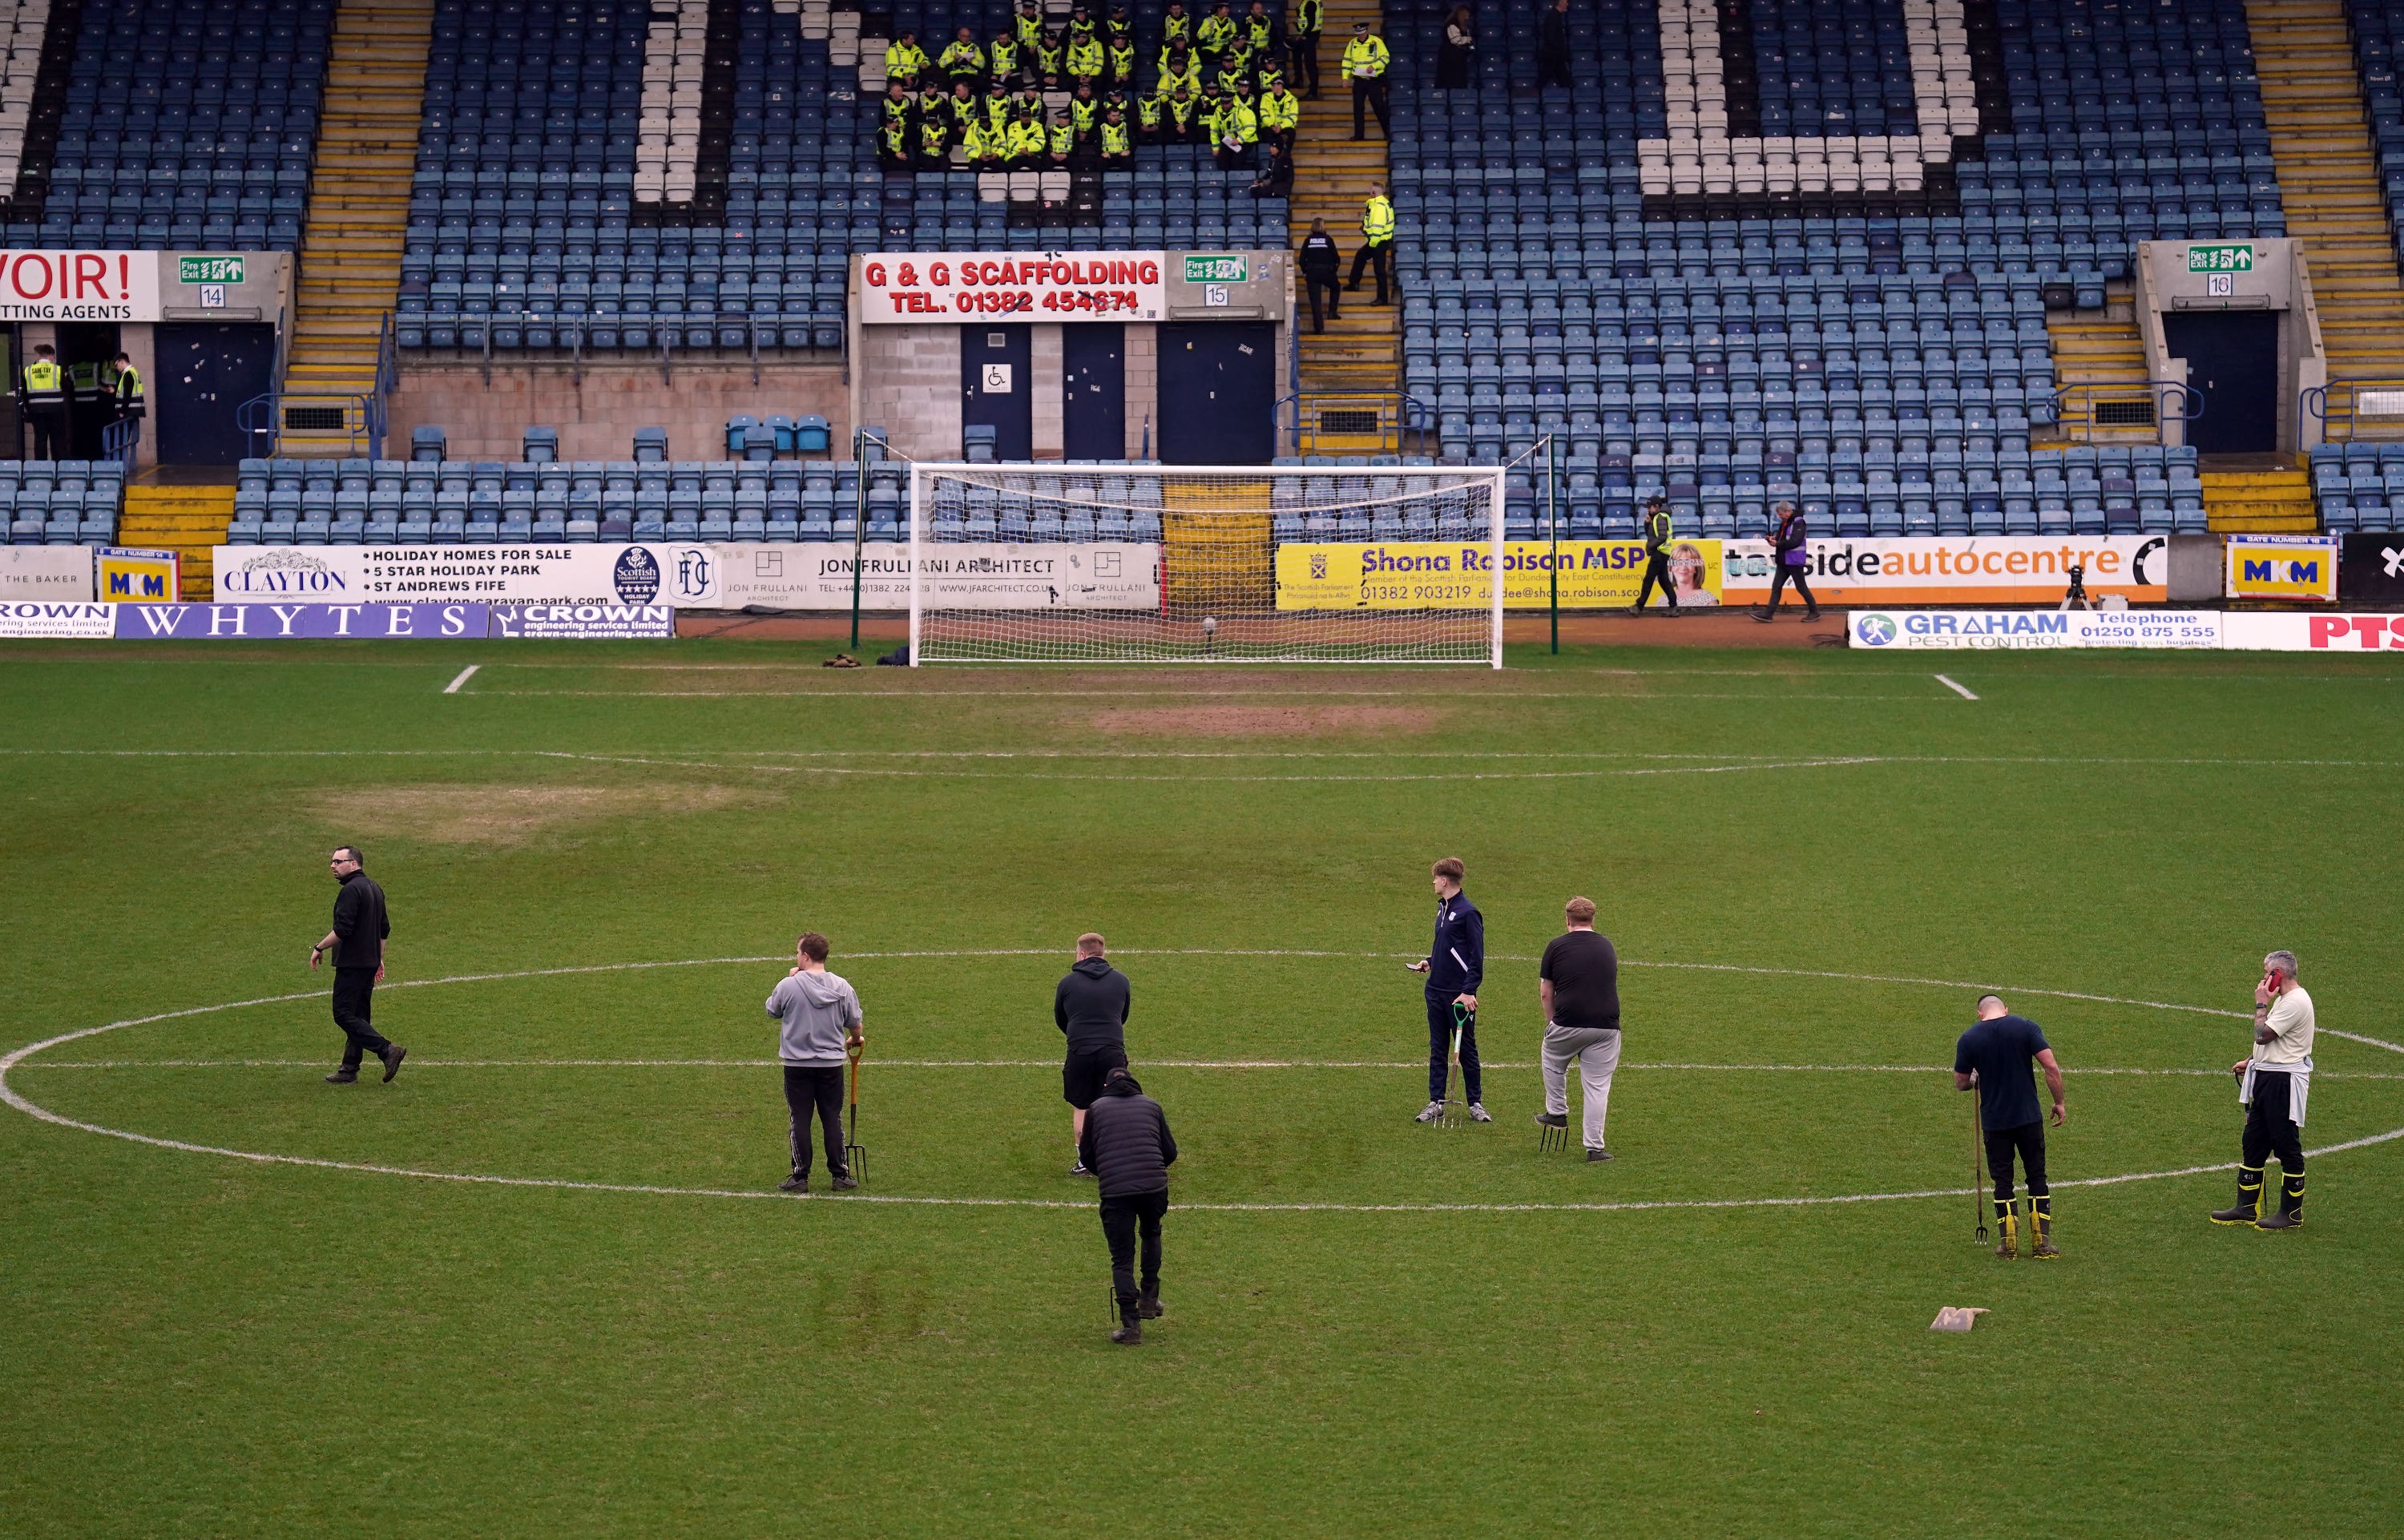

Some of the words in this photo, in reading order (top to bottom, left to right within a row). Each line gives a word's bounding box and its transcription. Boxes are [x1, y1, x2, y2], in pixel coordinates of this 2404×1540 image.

[2190, 250, 2207, 260] Fire
[181, 261, 199, 270] Fire
[1187, 260, 1203, 269] Fire
[2190, 260, 2208, 268] Exit
[181, 270, 200, 280] Exit
[865, 262, 886, 286] G
[897, 261, 918, 286] &
[930, 261, 950, 286] G
[961, 260, 1159, 285] SCAFFOLDING
[1187, 269, 1204, 278] Exit
[2211, 276, 2229, 292] 16
[204, 288, 222, 304] 14
[889, 292, 947, 312] TEL.
[956, 290, 1033, 312] 01382
[1042, 290, 1139, 312] 454674
[1208, 288, 1225, 303] 15
[61, 305, 131, 318] AGENTS
[2271, 536, 2309, 544] NUMBER
[127, 550, 155, 558] NUMBER
[373, 551, 438, 562] HOLIDAY
[444, 550, 496, 561] HOMES
[502, 550, 530, 560] FOR
[535, 550, 572, 559] SALE
[1362, 547, 1450, 572] Shona
[1582, 547, 1645, 570] MSP
[374, 567, 381, 576] 5
[387, 566, 425, 576] STAR
[431, 566, 495, 575] HOLIDAY
[502, 565, 541, 575] PARK
[617, 566, 655, 576] Scottish
[818, 559, 853, 575] JON
[2244, 559, 2317, 583] MKM
[6, 574, 30, 583] THE
[36, 574, 77, 583] BAKER
[224, 570, 347, 591] CLAYTON
[1410, 574, 1422, 583] the
[1425, 574, 1455, 583] Scottish
[1505, 572, 1515, 582] for
[1519, 572, 1551, 582] Dundee
[1556, 572, 1569, 583] City
[1572, 572, 1589, 582] East
[1591, 571, 1643, 583] Constituency
[111, 572, 163, 597] MKM
[374, 583, 392, 591] ST
[397, 581, 470, 591] ANDREWS
[475, 581, 506, 591] FIFE
[728, 584, 748, 592] JON
[753, 584, 807, 592] FRULLANI
[819, 584, 835, 592] TEL:
[894, 584, 910, 592] 224
[1067, 583, 1087, 592] JON
[1092, 583, 1145, 592] FRULLANI
[1297, 583, 1319, 591] Scottish
[1321, 583, 1353, 591] Parliament
[1361, 586, 1408, 599] 01382
[1414, 586, 1471, 599] 903219
[524, 606, 669, 622] CROWN
[2096, 613, 2197, 626] Telephone
[72, 620, 110, 628] limited
[136, 605, 466, 635] WHYTES
[1905, 614, 2068, 634] GRAHAM
[524, 621, 585, 631] engineering
[587, 621, 628, 630] services
[631, 621, 668, 630] limited
[524, 630, 668, 639] crown-engineering.co.uk
[2081, 627, 2135, 637] 01250
[2141, 627, 2173, 637] 875
[2181, 627, 2215, 637] 555
[1909, 635, 1962, 647] PEST
[1968, 635, 2068, 648] CONTROL
